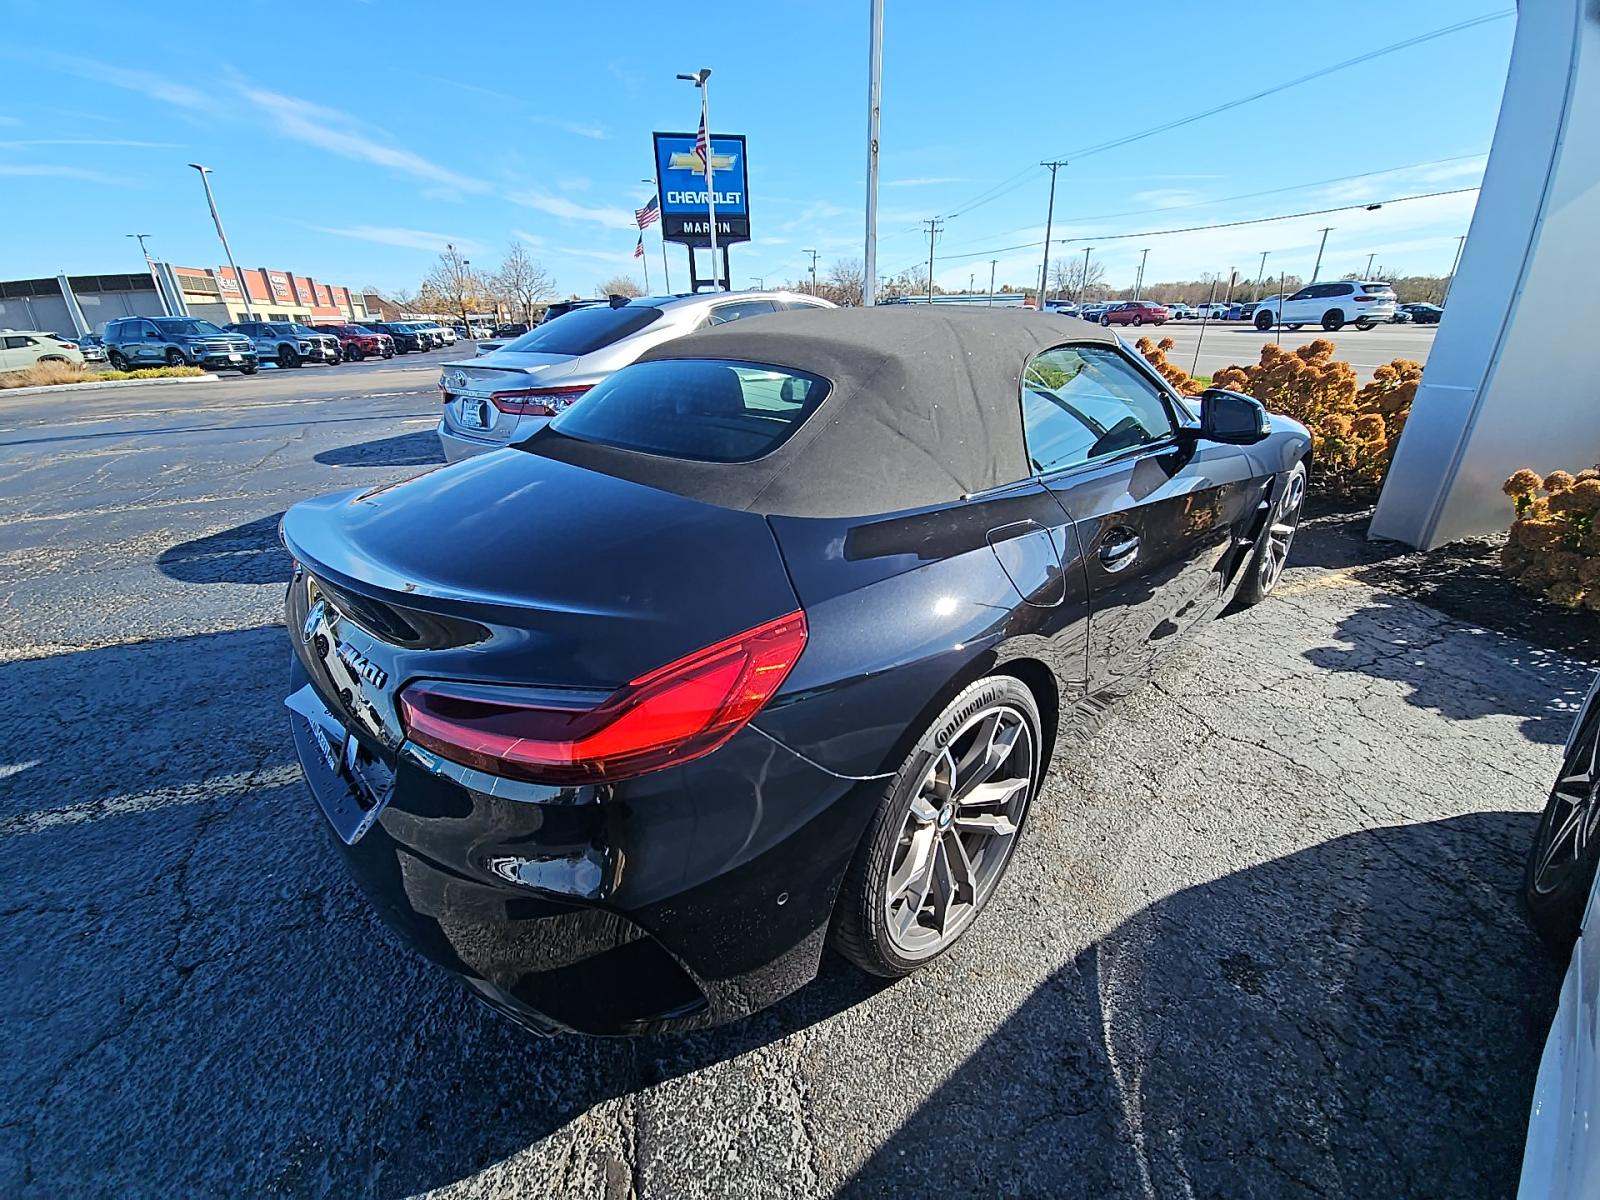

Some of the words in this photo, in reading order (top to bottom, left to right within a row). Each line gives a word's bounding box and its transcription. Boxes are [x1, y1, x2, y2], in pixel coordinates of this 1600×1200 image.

[667, 191, 741, 204] CHEVROLET
[683, 221, 731, 233] MARIN
[935, 687, 996, 748] Continental
